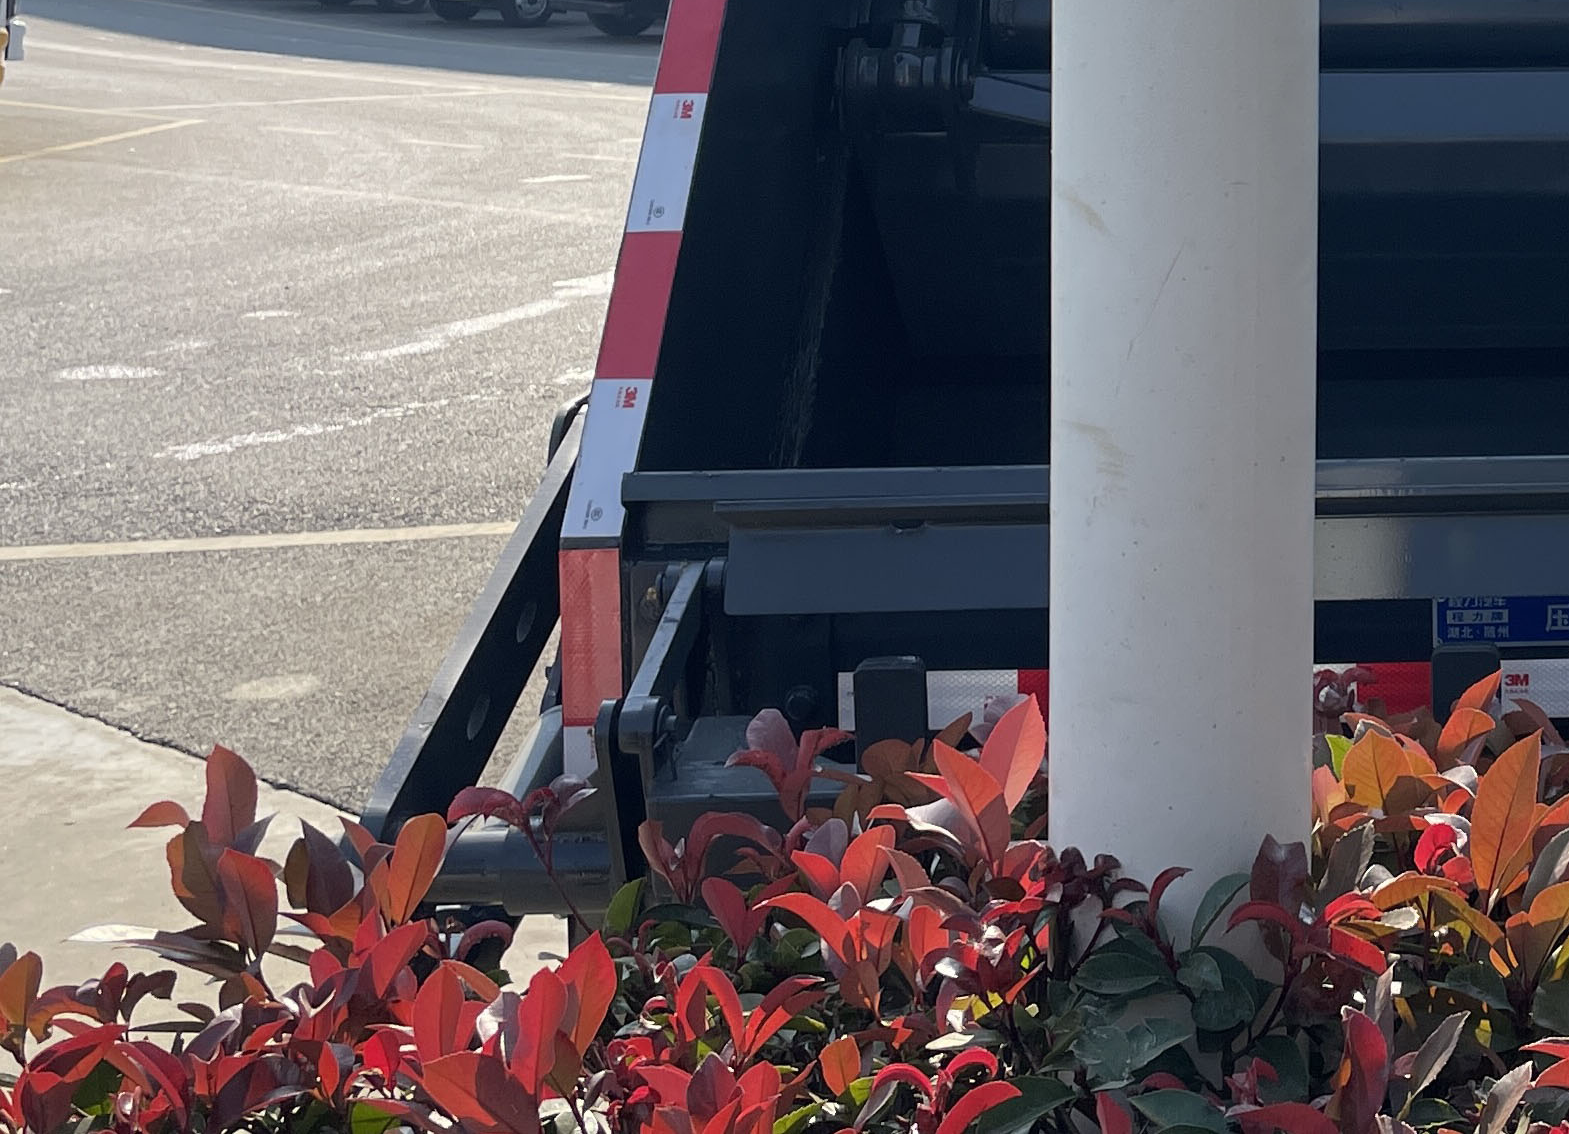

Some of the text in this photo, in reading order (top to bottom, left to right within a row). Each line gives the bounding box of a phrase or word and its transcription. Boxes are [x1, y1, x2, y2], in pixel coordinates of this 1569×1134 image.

[680, 99, 695, 120] 3M
[622, 386, 638, 408] 3M
[1504, 673, 1530, 687] 3M
